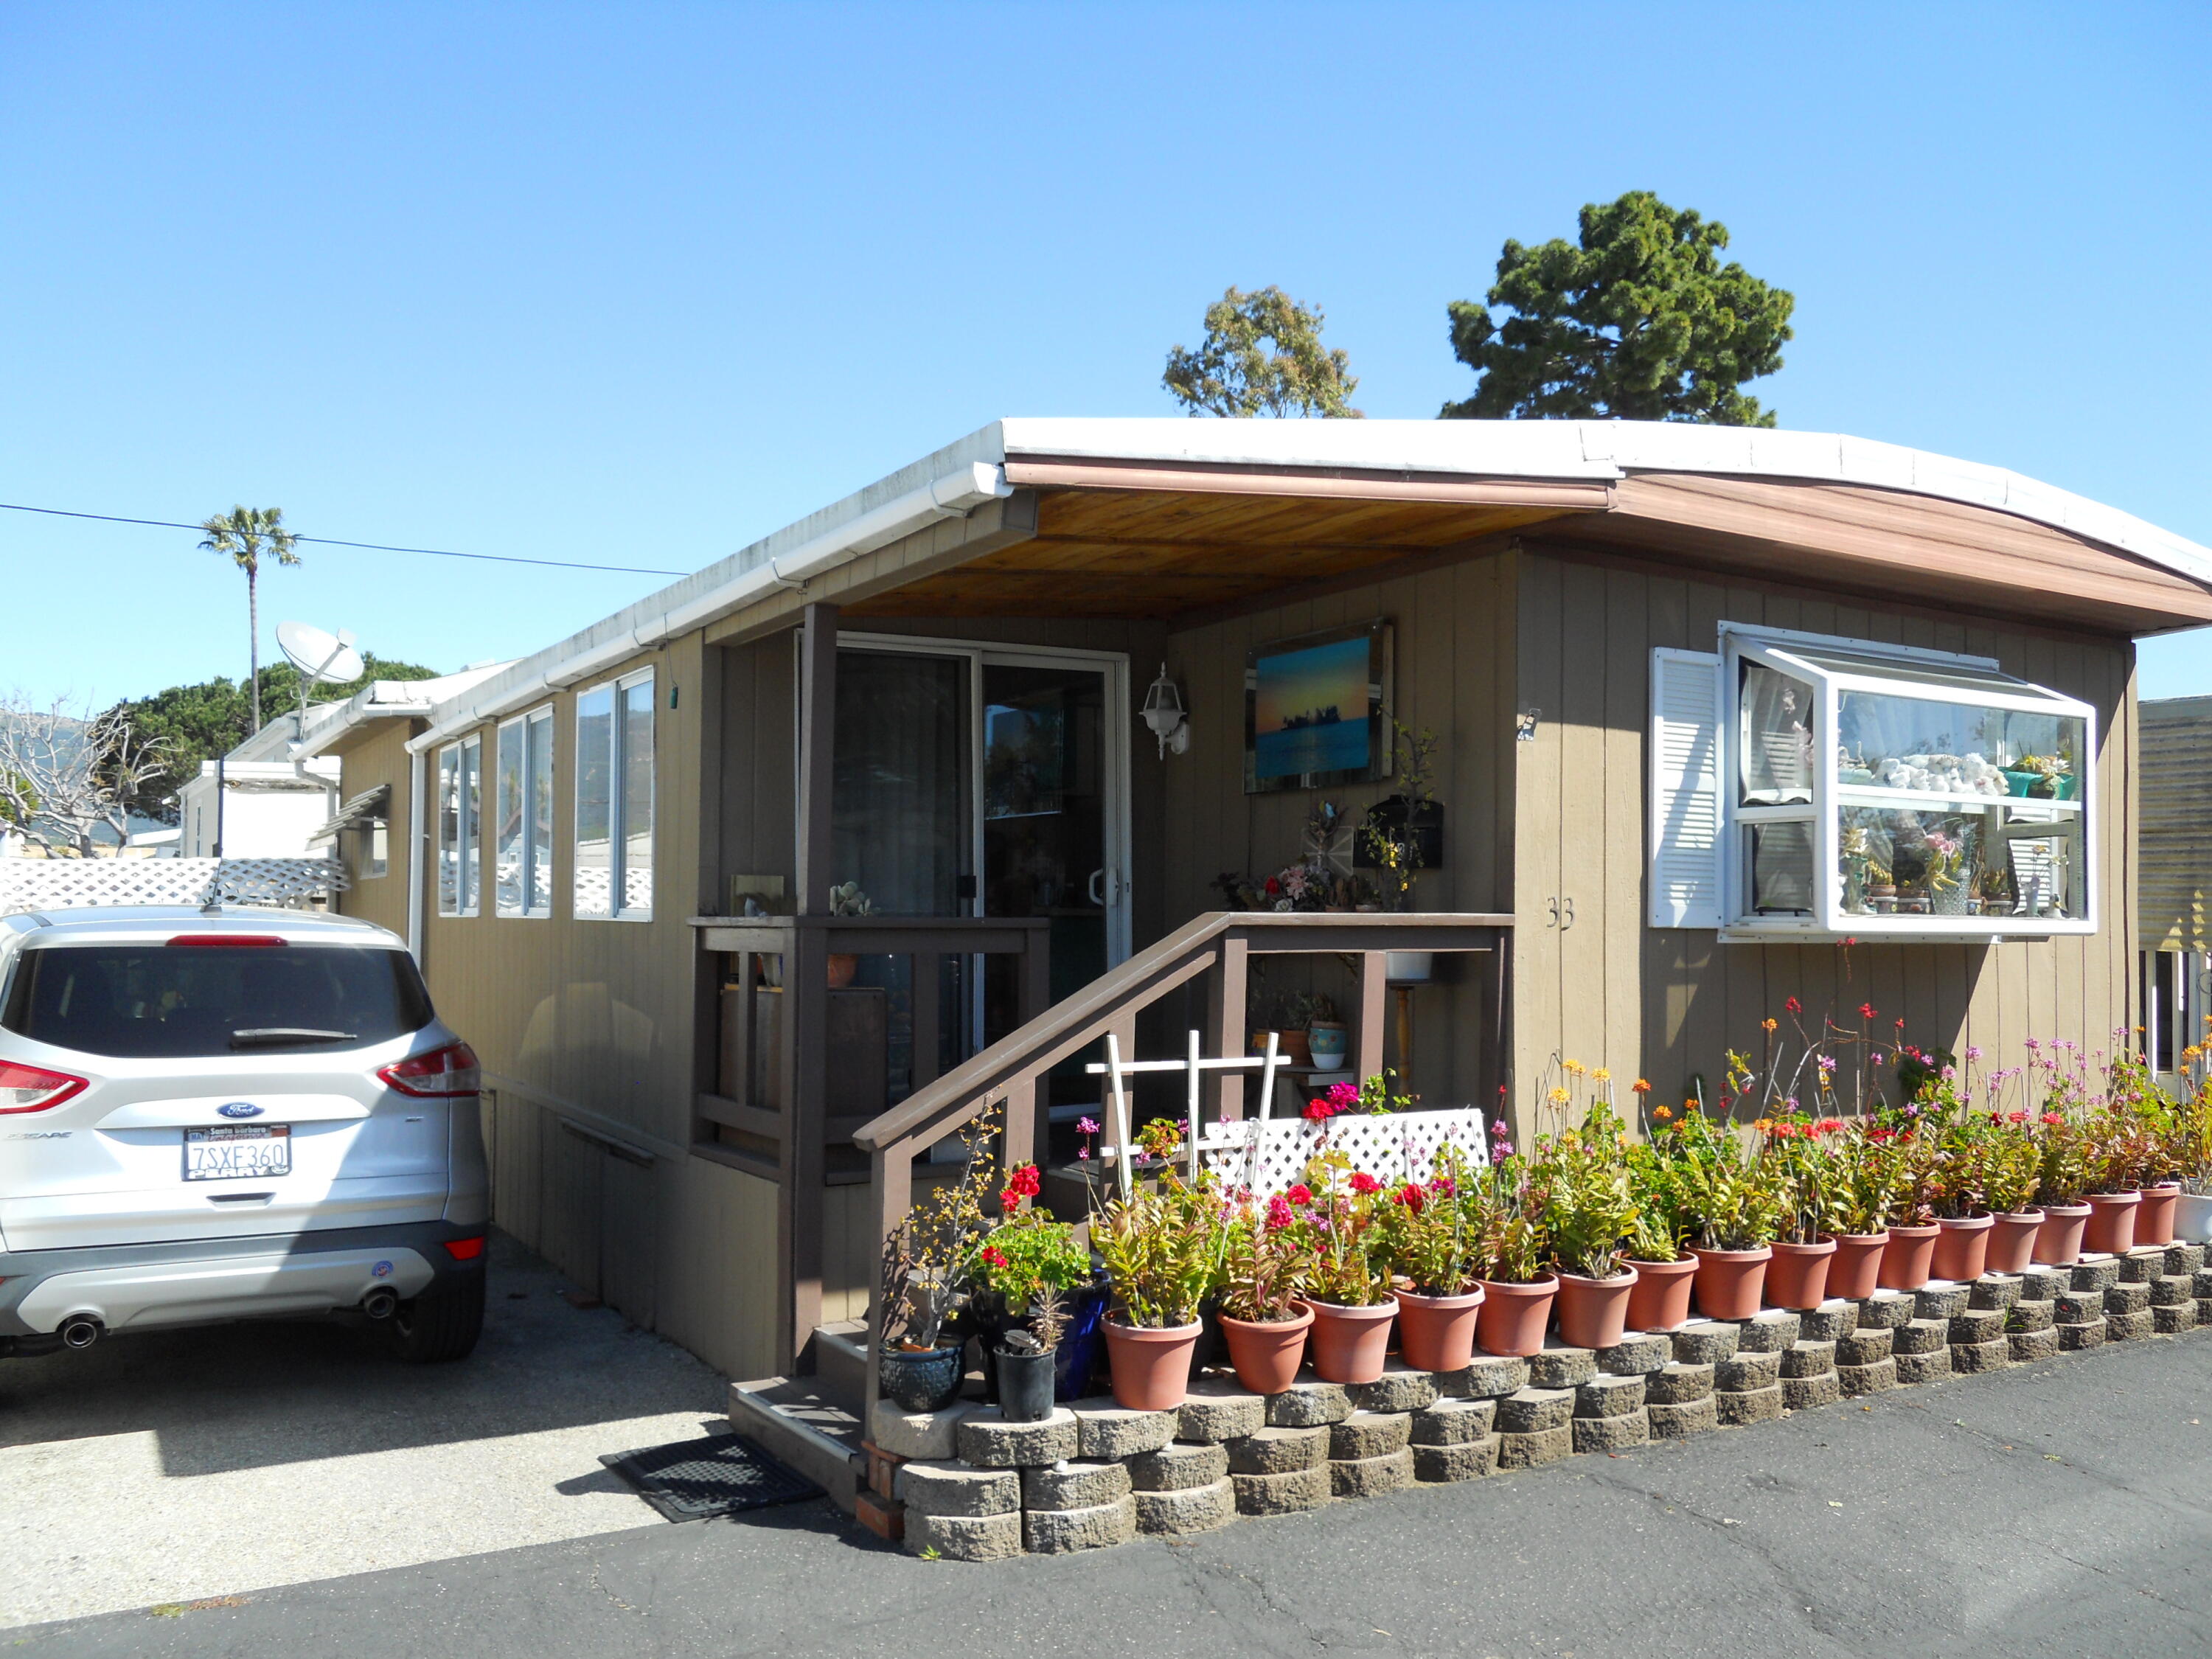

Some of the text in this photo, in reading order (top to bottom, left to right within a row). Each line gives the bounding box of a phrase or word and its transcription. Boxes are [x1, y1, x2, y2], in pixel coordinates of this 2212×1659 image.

[1546, 896, 1575, 932] 33
[227, 1104, 254, 1115] Ford
[193, 1144, 284, 1169] 7SXF360
